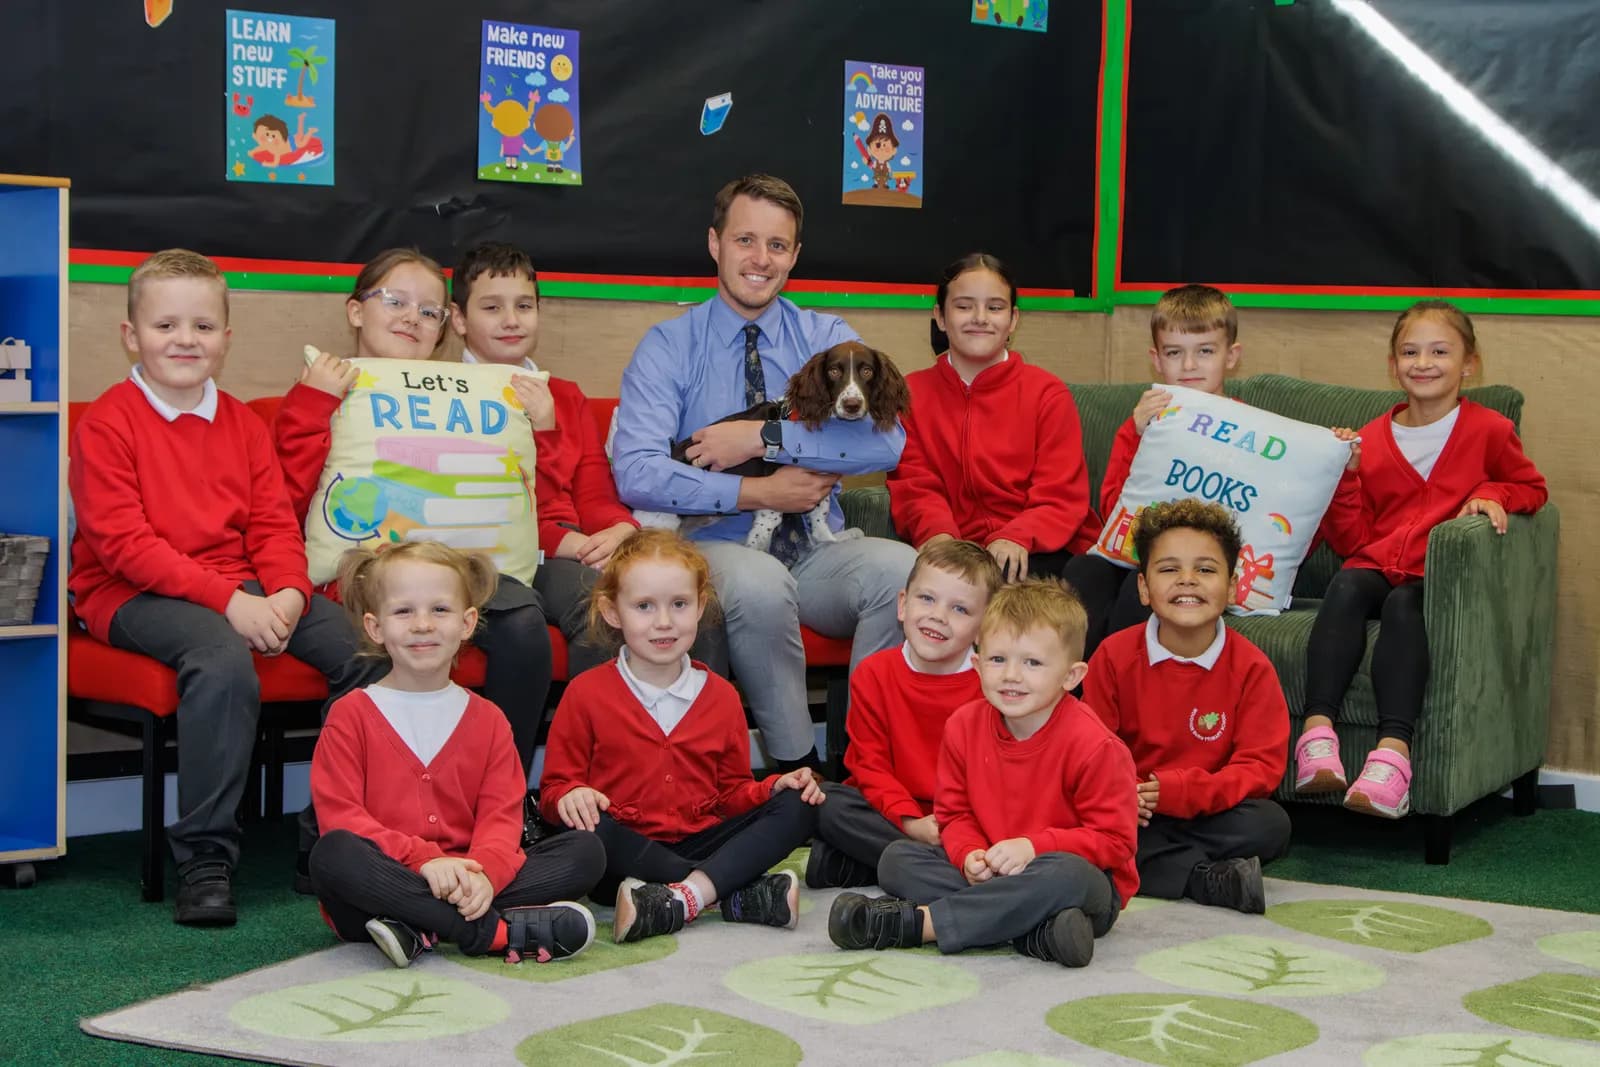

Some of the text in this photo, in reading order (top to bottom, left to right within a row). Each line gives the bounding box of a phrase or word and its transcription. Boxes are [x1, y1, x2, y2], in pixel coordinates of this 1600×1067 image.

[232, 17, 291, 44] LEARN
[487, 24, 565, 50] Make new
[233, 43, 273, 63] new
[486, 46, 546, 71] FRIENDS
[232, 64, 288, 89] STUFF
[870, 64, 922, 85] Take you
[855, 92, 922, 113] ADVENTURE
[887, 83, 922, 97] on an
[401, 371, 470, 394] Let's
[369, 392, 509, 436] READ
[1187, 413, 1287, 461] READ
[1164, 458, 1258, 513] BOOKS
